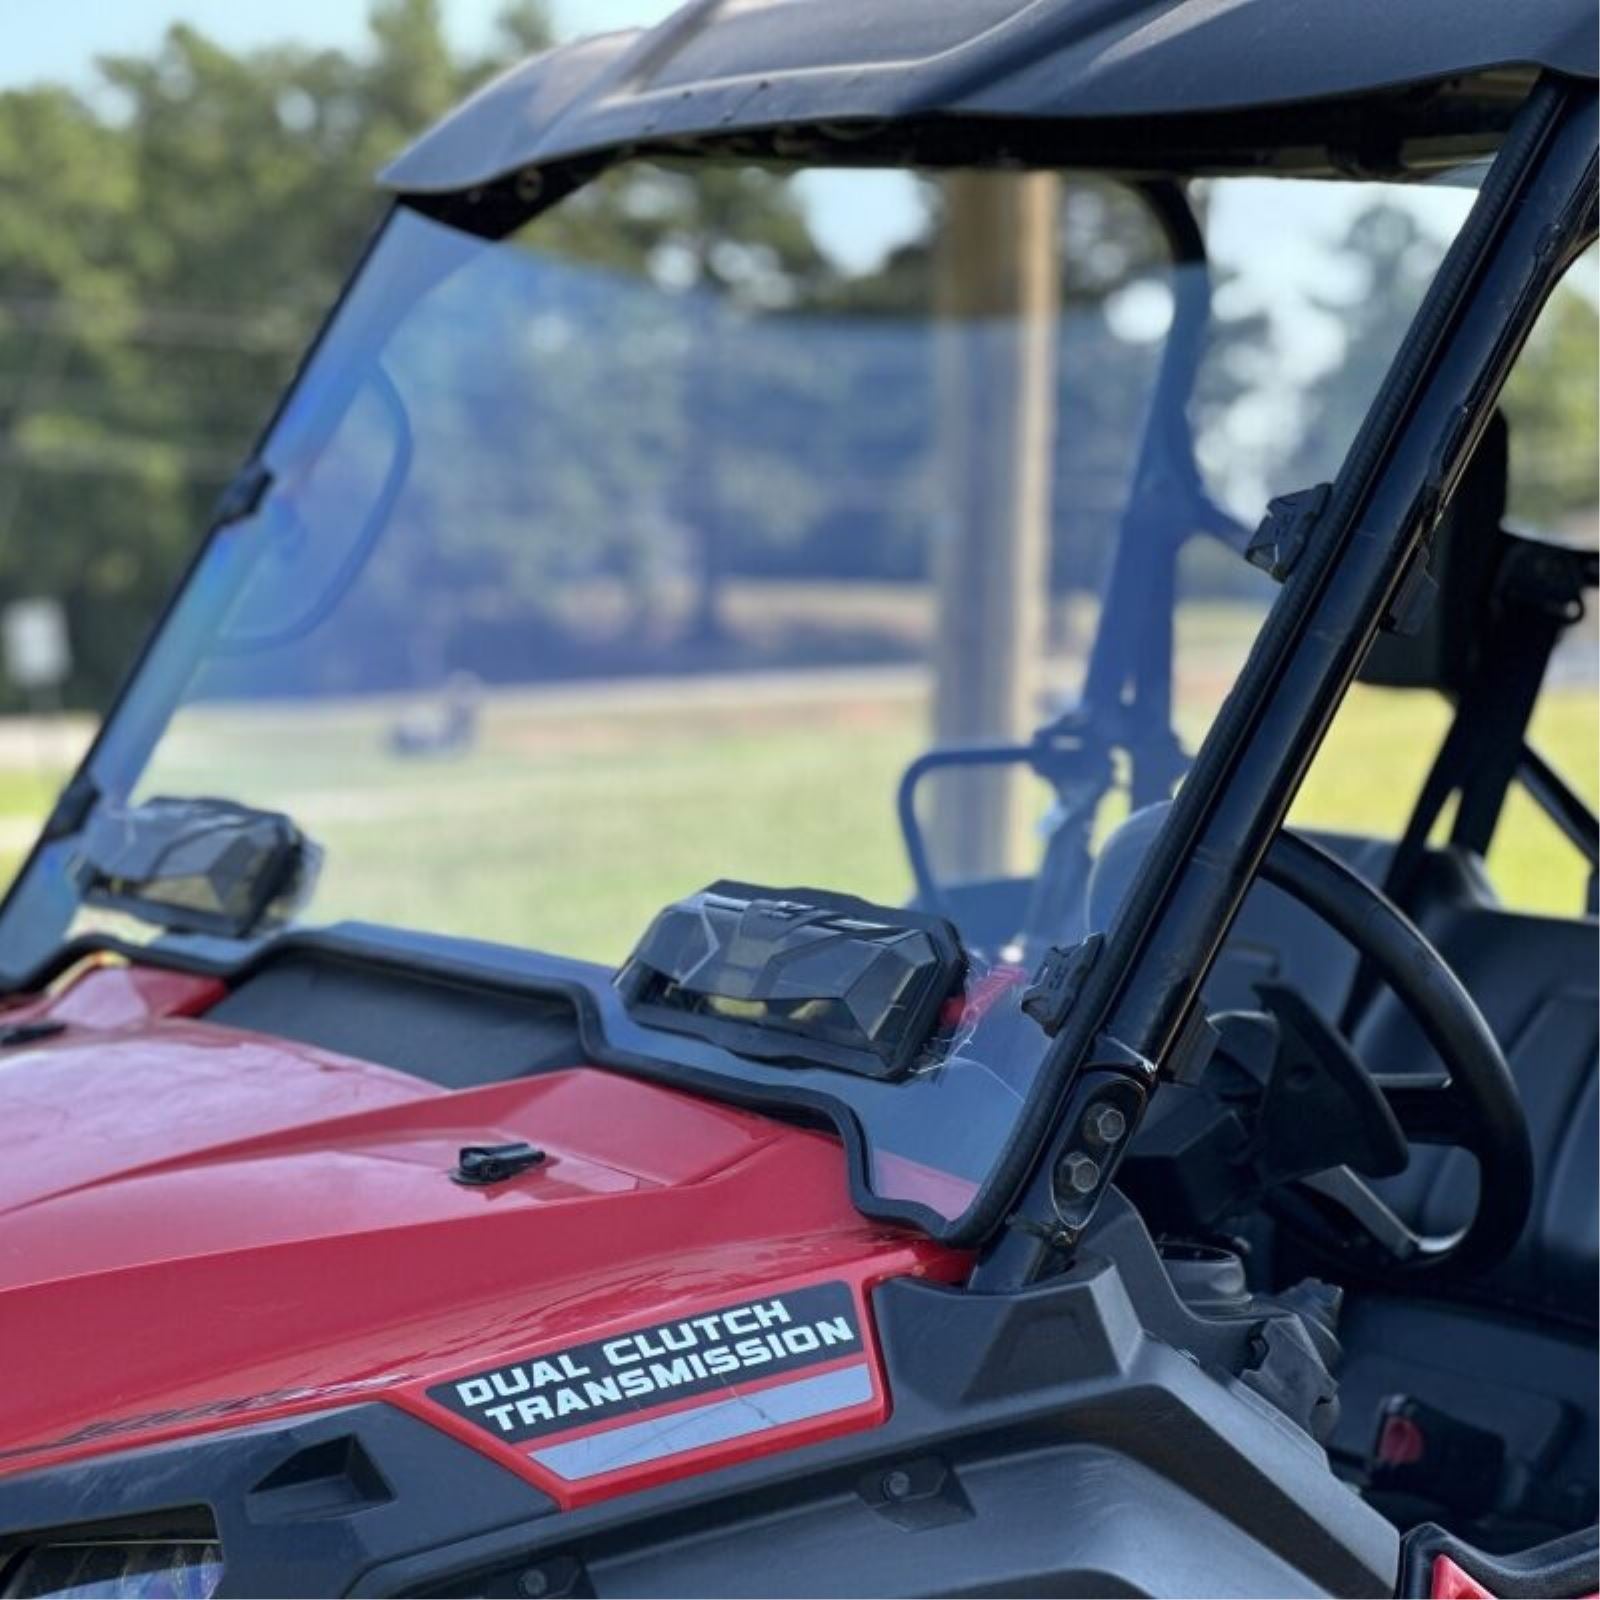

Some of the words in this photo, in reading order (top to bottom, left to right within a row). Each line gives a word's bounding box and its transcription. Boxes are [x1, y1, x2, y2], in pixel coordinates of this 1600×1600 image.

[456, 1354, 590, 1406] DUAL
[602, 1300, 791, 1366] CLUTCH
[485, 1316, 854, 1431] TRANSMISSION
